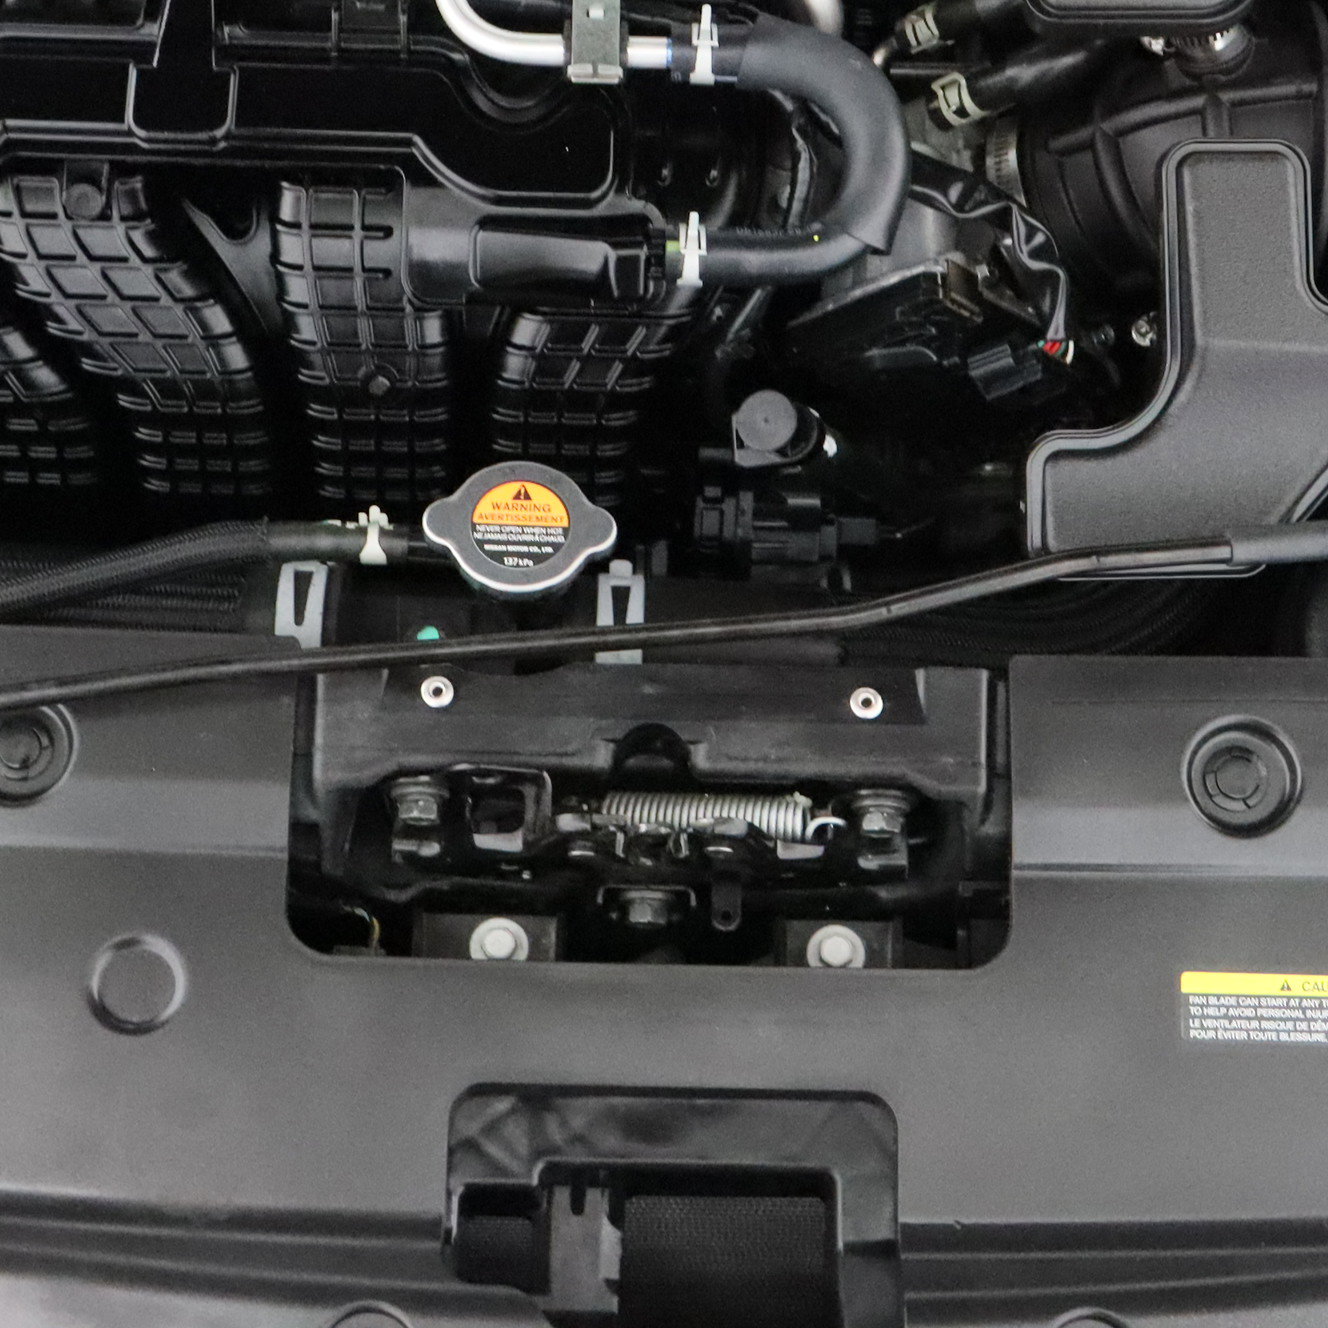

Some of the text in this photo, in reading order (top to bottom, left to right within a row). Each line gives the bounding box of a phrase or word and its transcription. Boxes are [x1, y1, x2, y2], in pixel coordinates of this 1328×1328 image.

[492, 502, 551, 512] WARNING
[478, 513, 564, 523] AVERTISSEMENT
[504, 557, 518, 566] 137
[1189, 996, 1207, 1005] FAN
[1208, 997, 1237, 1006] BLADE
[1239, 998, 1259, 1006] CAN
[1260, 999, 1288, 1007] START
[1289, 999, 1300, 1007] AT
[1302, 999, 1319, 1008] ANY
[1190, 1006, 1202, 1015] TO
[1204, 1007, 1227, 1016] HELP
[1228, 1008, 1255, 1017] AVOID
[1257, 1009, 1304, 1019] PERSONAL
[1190, 1019, 1201, 1028] LE
[1202, 1019, 1260, 1029] VENTILATEUR
[1261, 1021, 1295, 1030] RISQUE
[1296, 1022, 1309, 1031] DE
[1190, 1030, 1216, 1040] POUR
[1250, 1031, 1278, 1041] TOUTE
